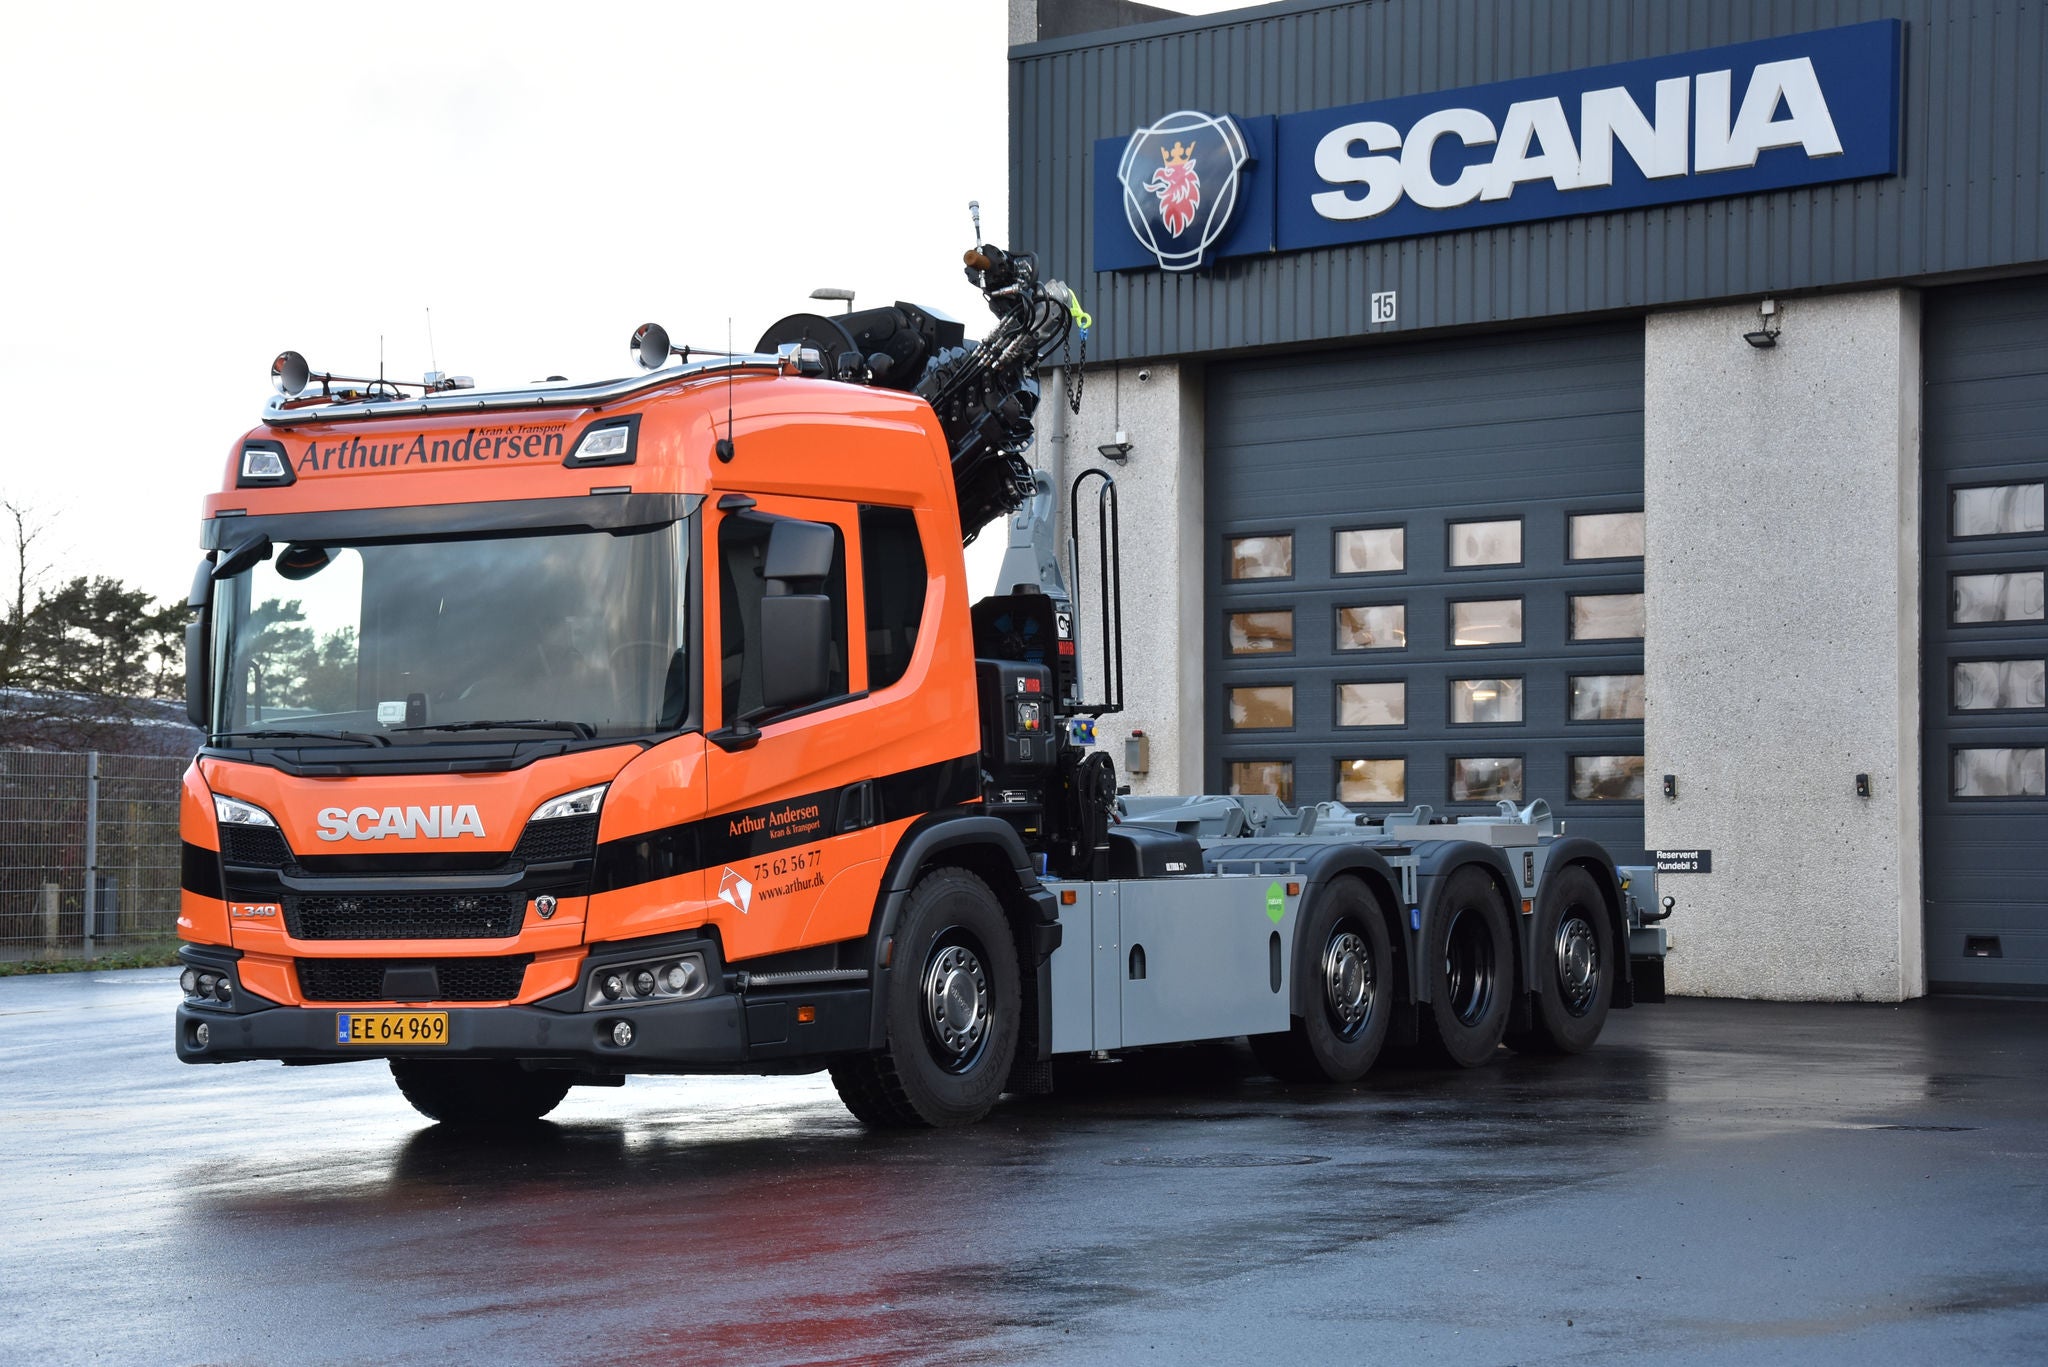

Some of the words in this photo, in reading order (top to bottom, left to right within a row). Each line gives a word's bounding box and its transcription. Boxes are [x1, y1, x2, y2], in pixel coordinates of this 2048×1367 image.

[1310, 56, 1844, 221] SCANIA
[1373, 294, 1395, 320] 15
[479, 427, 503, 437] Kran
[506, 426, 513, 435] &
[518, 423, 567, 435] Transport
[297, 436, 404, 472] Arthur
[404, 428, 564, 464] Andersen
[315, 804, 486, 842] SCANIA
[729, 815, 766, 838] Arthur
[769, 805, 819, 827] Andersen
[770, 829, 785, 839] Kran
[785, 826, 792, 836] &
[793, 820, 820, 833] Transport
[754, 863, 769, 881] 75
[773, 858, 787, 876] 62
[791, 854, 805, 872] 56
[808, 849, 822, 867] 77
[1656, 851, 1698, 859] Reserveret
[1657, 861, 1690, 870] Kundebil
[1692, 861, 1698, 870] 3
[759, 872, 824, 901] www.arthur.dk
[232, 906, 243, 917] L
[243, 906, 276, 917] 340
[351, 1018, 375, 1039] EE
[381, 1017, 403, 1039] 64
[408, 1017, 444, 1039] 969
